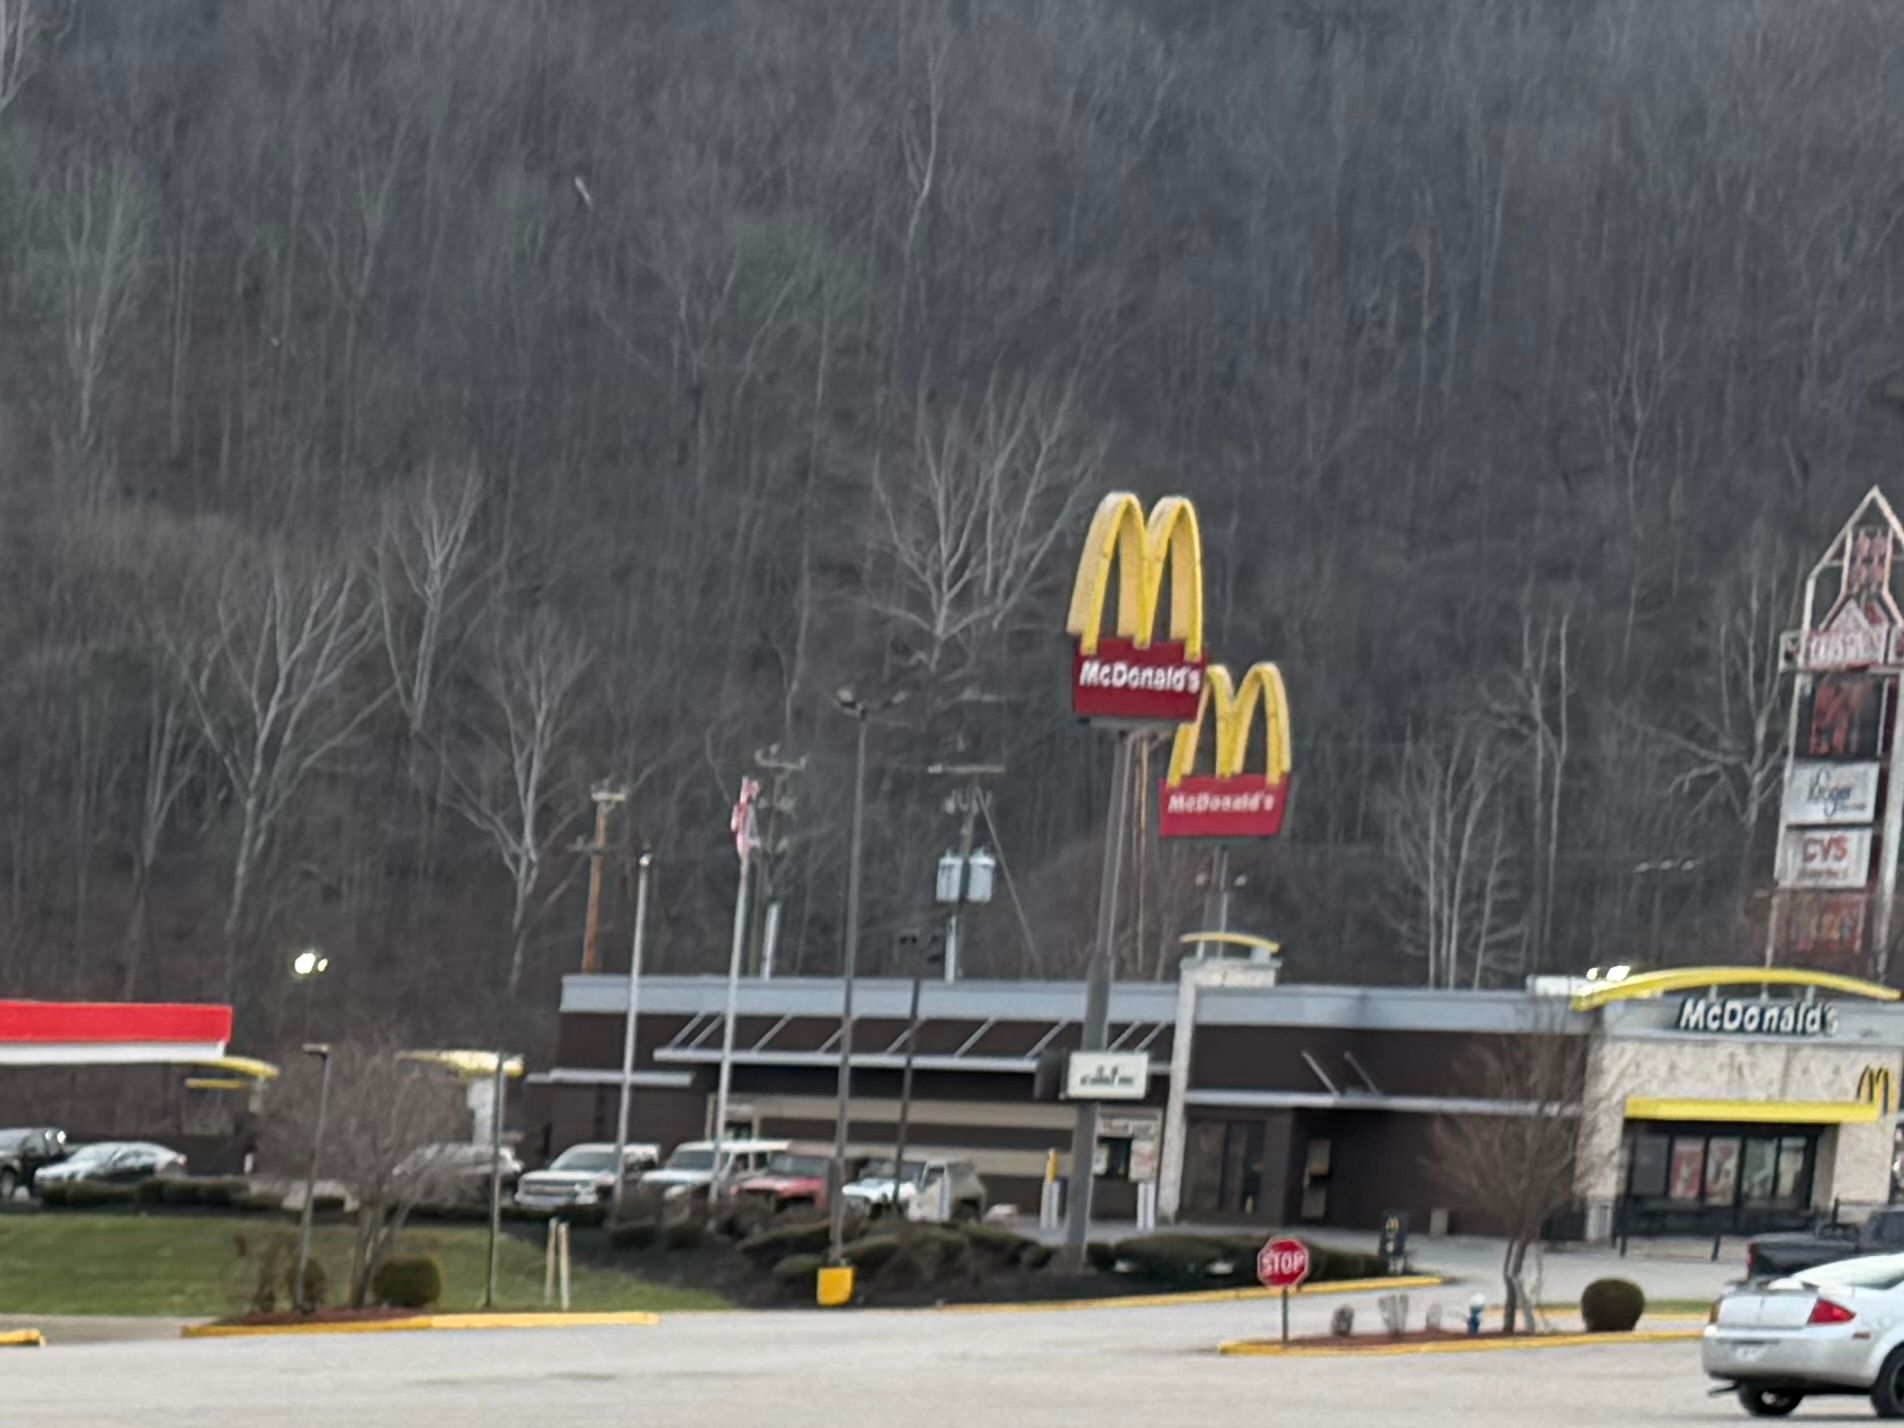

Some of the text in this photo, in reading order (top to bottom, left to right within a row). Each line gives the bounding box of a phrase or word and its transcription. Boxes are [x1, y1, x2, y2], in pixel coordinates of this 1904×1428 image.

[1079, 660, 1201, 694] McDonald's
[1167, 793, 1275, 813] McDonald's
[1803, 834, 1849, 863] CVS
[1679, 999, 1840, 1037] McDonald's
[1261, 1249, 1305, 1276] STOP
